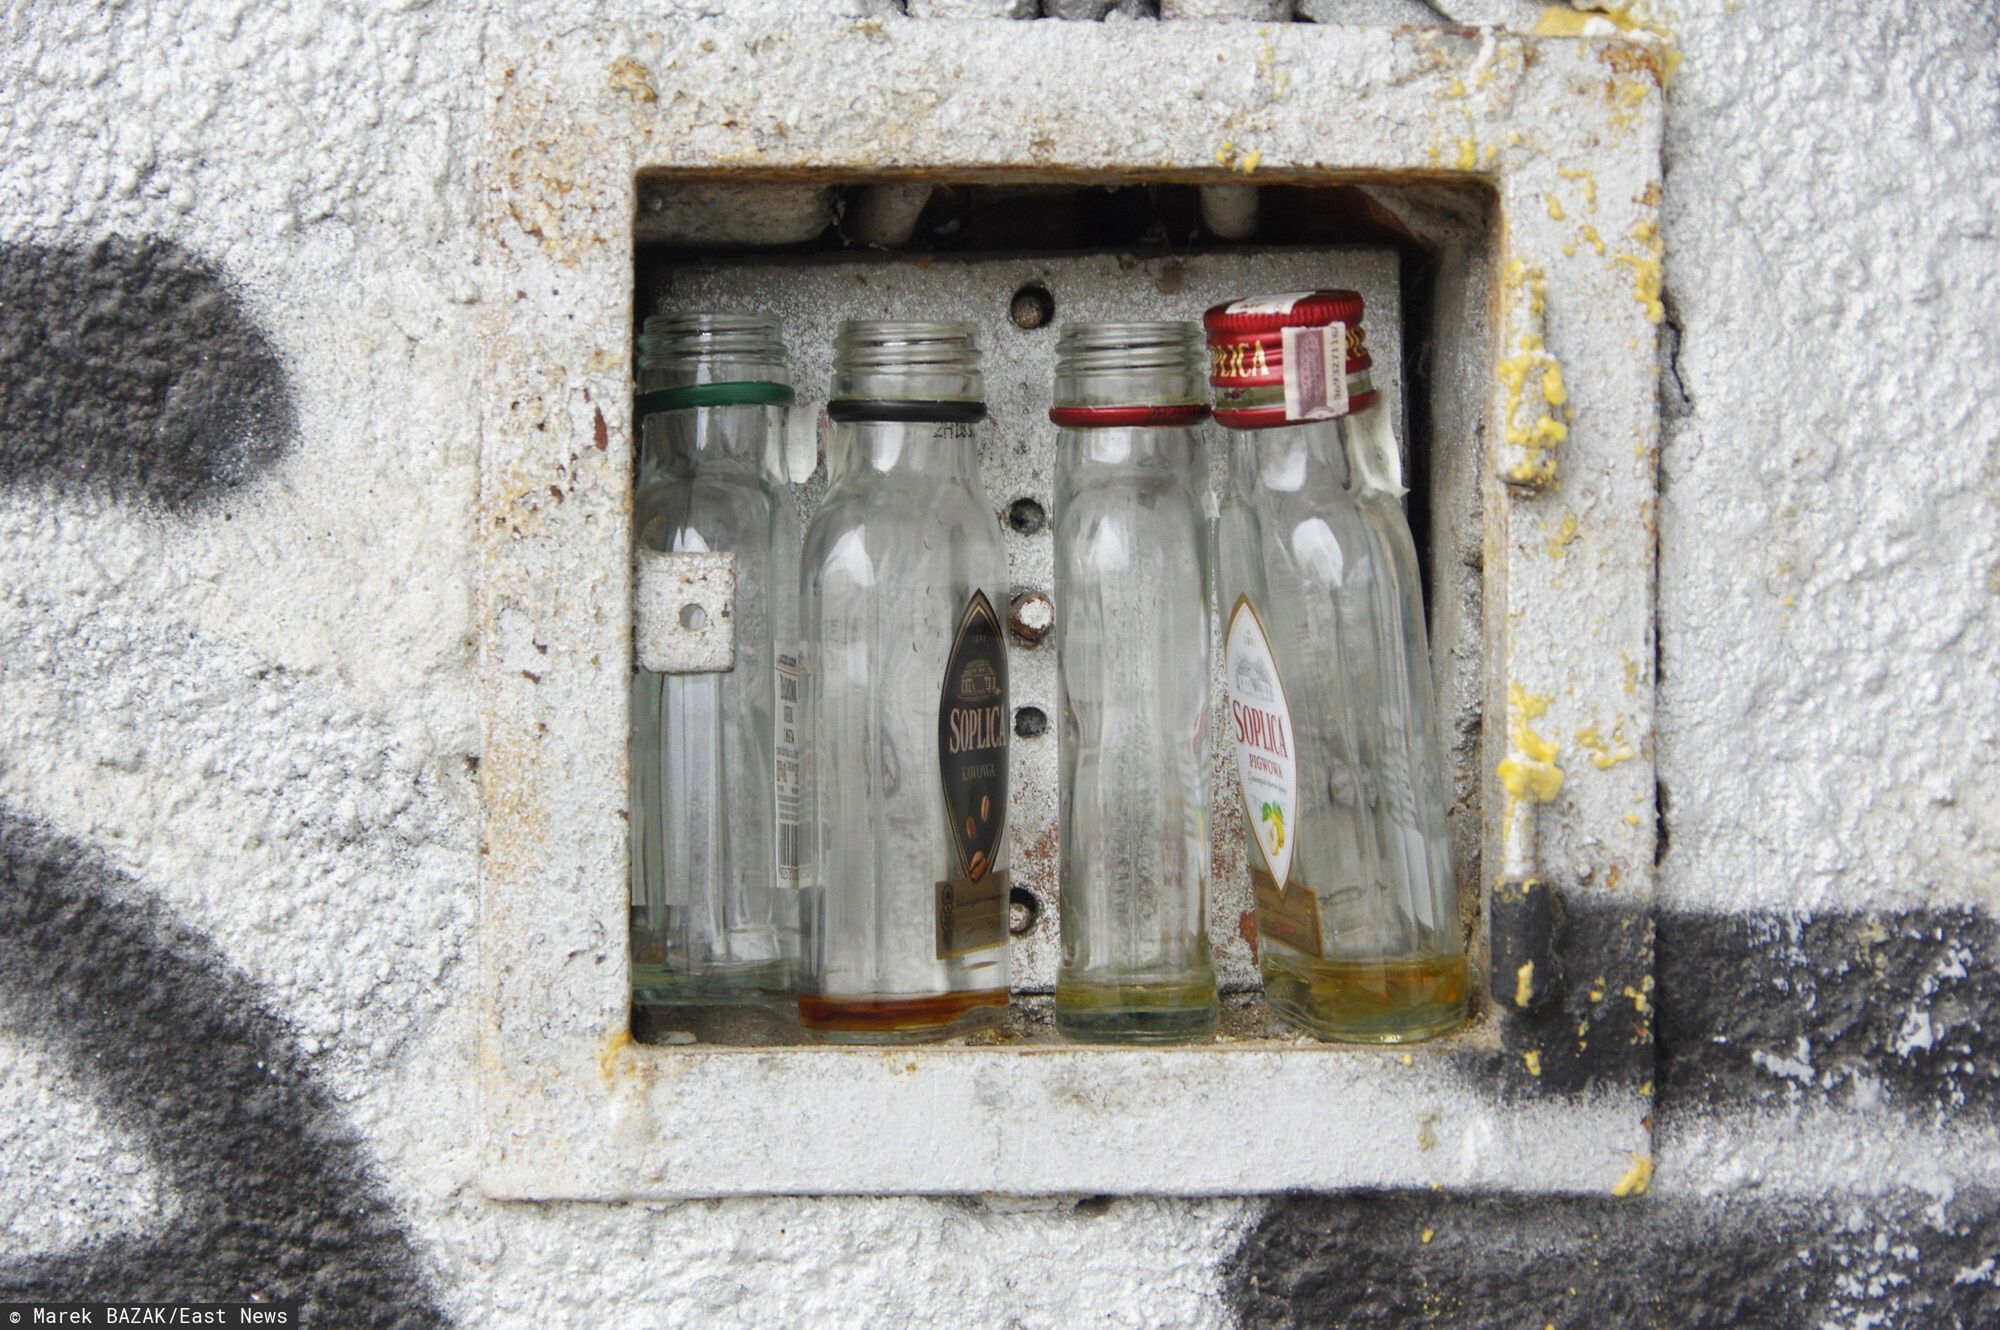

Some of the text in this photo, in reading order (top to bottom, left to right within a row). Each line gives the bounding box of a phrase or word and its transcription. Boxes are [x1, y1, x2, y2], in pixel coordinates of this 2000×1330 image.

[950, 702, 1007, 753] SOPLICA
[1232, 699, 1288, 758] SOPLICA
[1249, 754, 1284, 779] PIGWOWA
